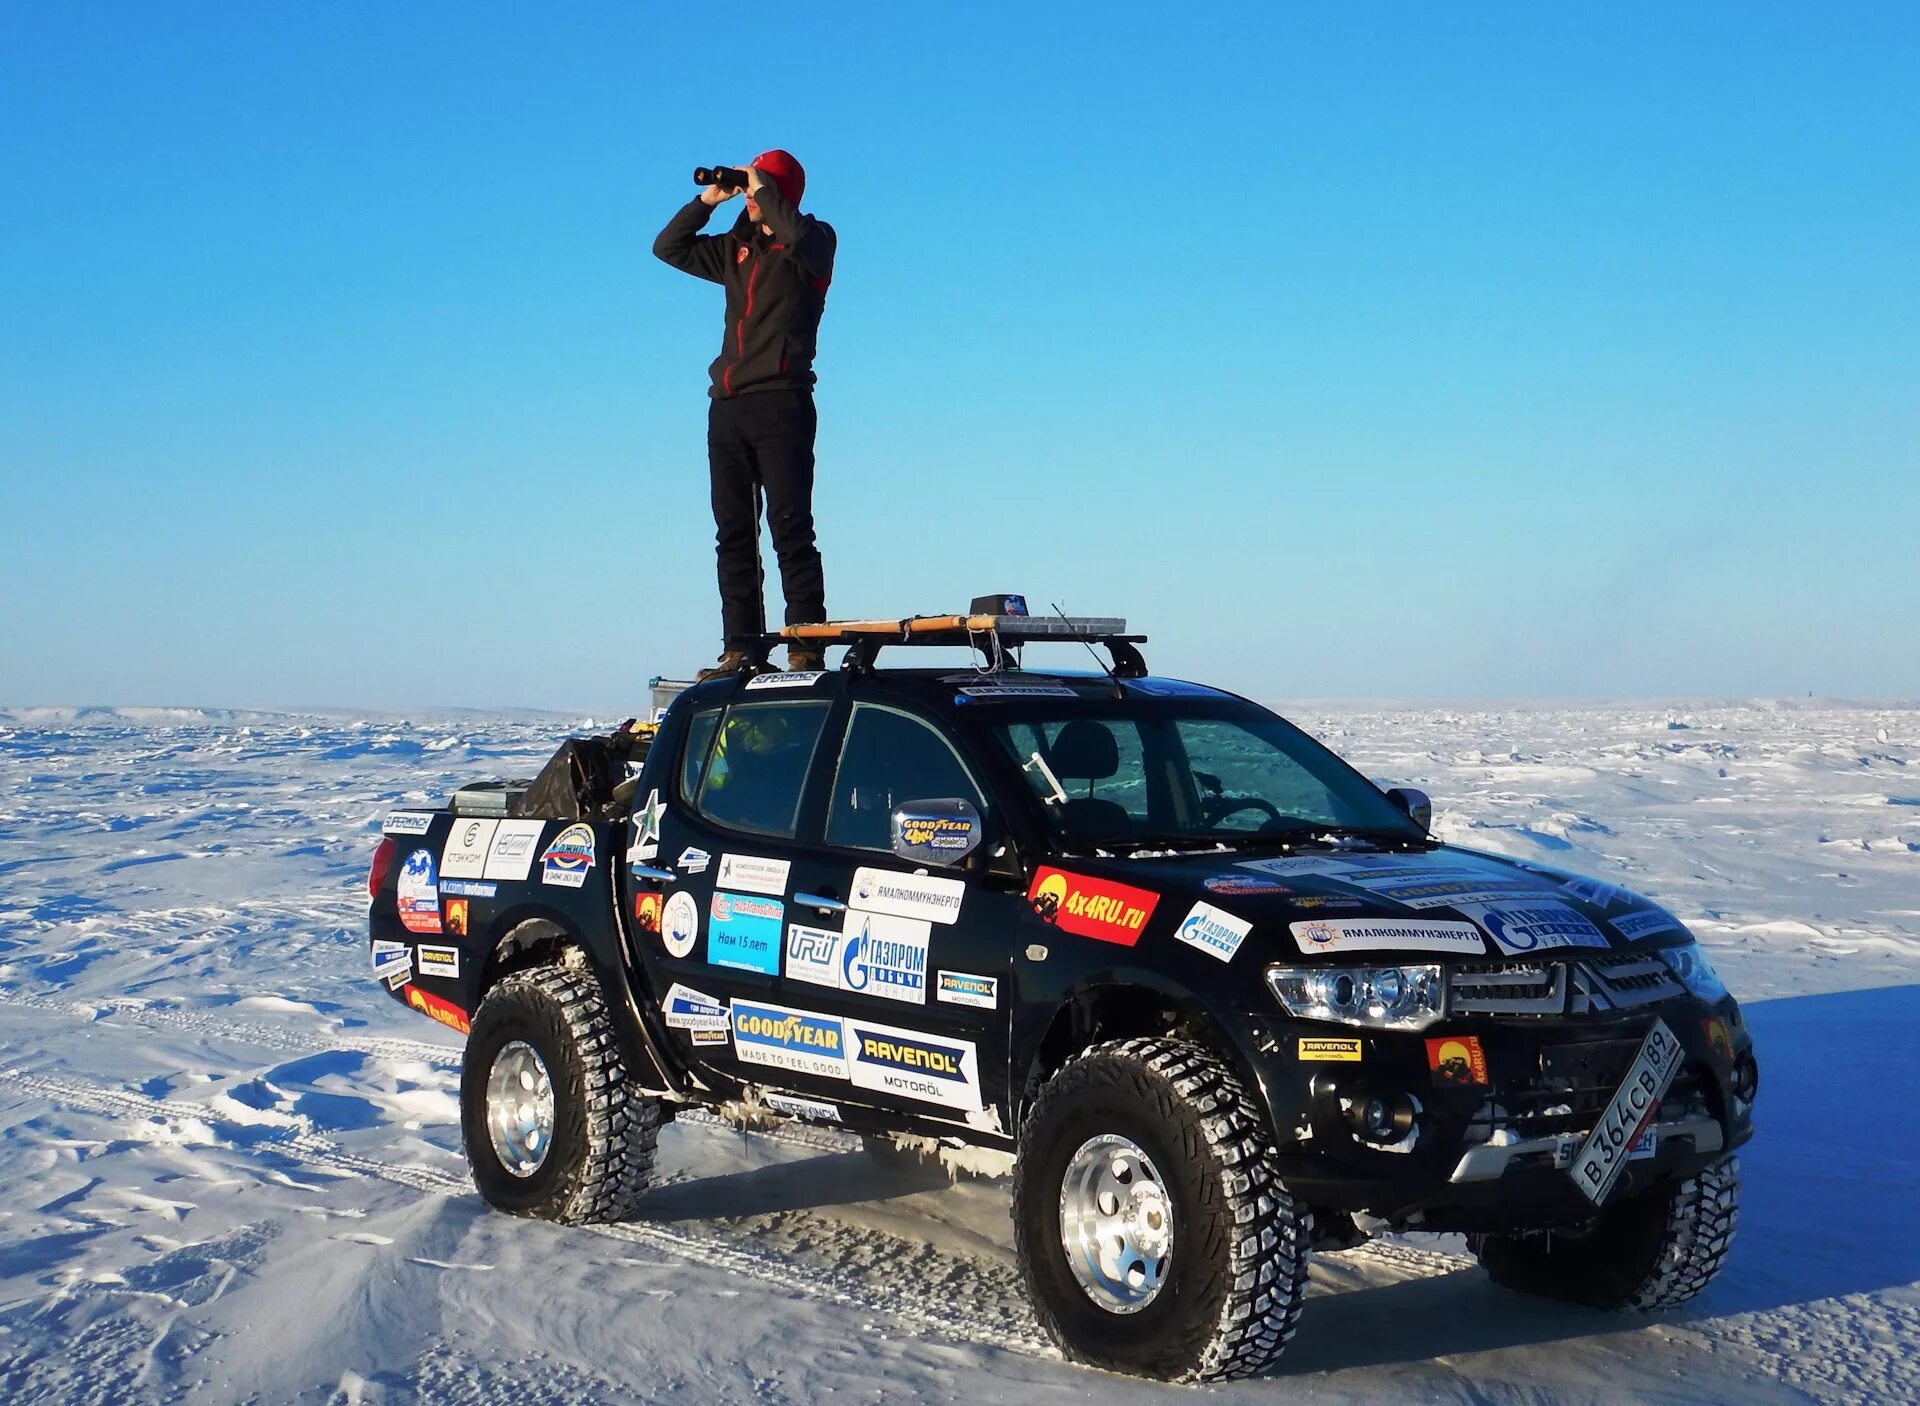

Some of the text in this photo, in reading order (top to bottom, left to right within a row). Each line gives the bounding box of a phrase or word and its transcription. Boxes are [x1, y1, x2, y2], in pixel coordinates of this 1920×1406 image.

[904, 819, 971, 831] GOODYEAR
[877, 885, 960, 909] ЯМАЛКОММУНЭНЕРГО
[1066, 890, 1146, 930] 4x4RU.ru
[718, 932, 768, 952] Нам 15 лет
[1203, 920, 1242, 946] ГАЗПРОМ
[1342, 928, 1480, 942] ЯМАЛКОММУНЭНЕРГО
[423, 951, 454, 962] RAVENOL
[871, 939, 925, 972] ГАЗПРОМ
[870, 967, 922, 988] ДОБЫЧА
[943, 978, 992, 994] RAVENOL
[952, 996, 981, 1006] MOTORÖL
[694, 1031, 724, 1041] GOODYEAR
[737, 1014, 839, 1050] GOODYEAR
[742, 1049, 768, 1063] MADE
[771, 1053, 784, 1064] TO
[864, 1039, 957, 1073] RAVENOL
[1307, 1042, 1353, 1051] RAVENOL
[1646, 1031, 1667, 1065] 89
[1469, 1035, 1487, 1084] 4x4RU.ru
[1657, 1054, 1672, 1073] RUS
[884, 1074, 944, 1097] MOTORÖL
[770, 1100, 838, 1121] SUPERINCH
